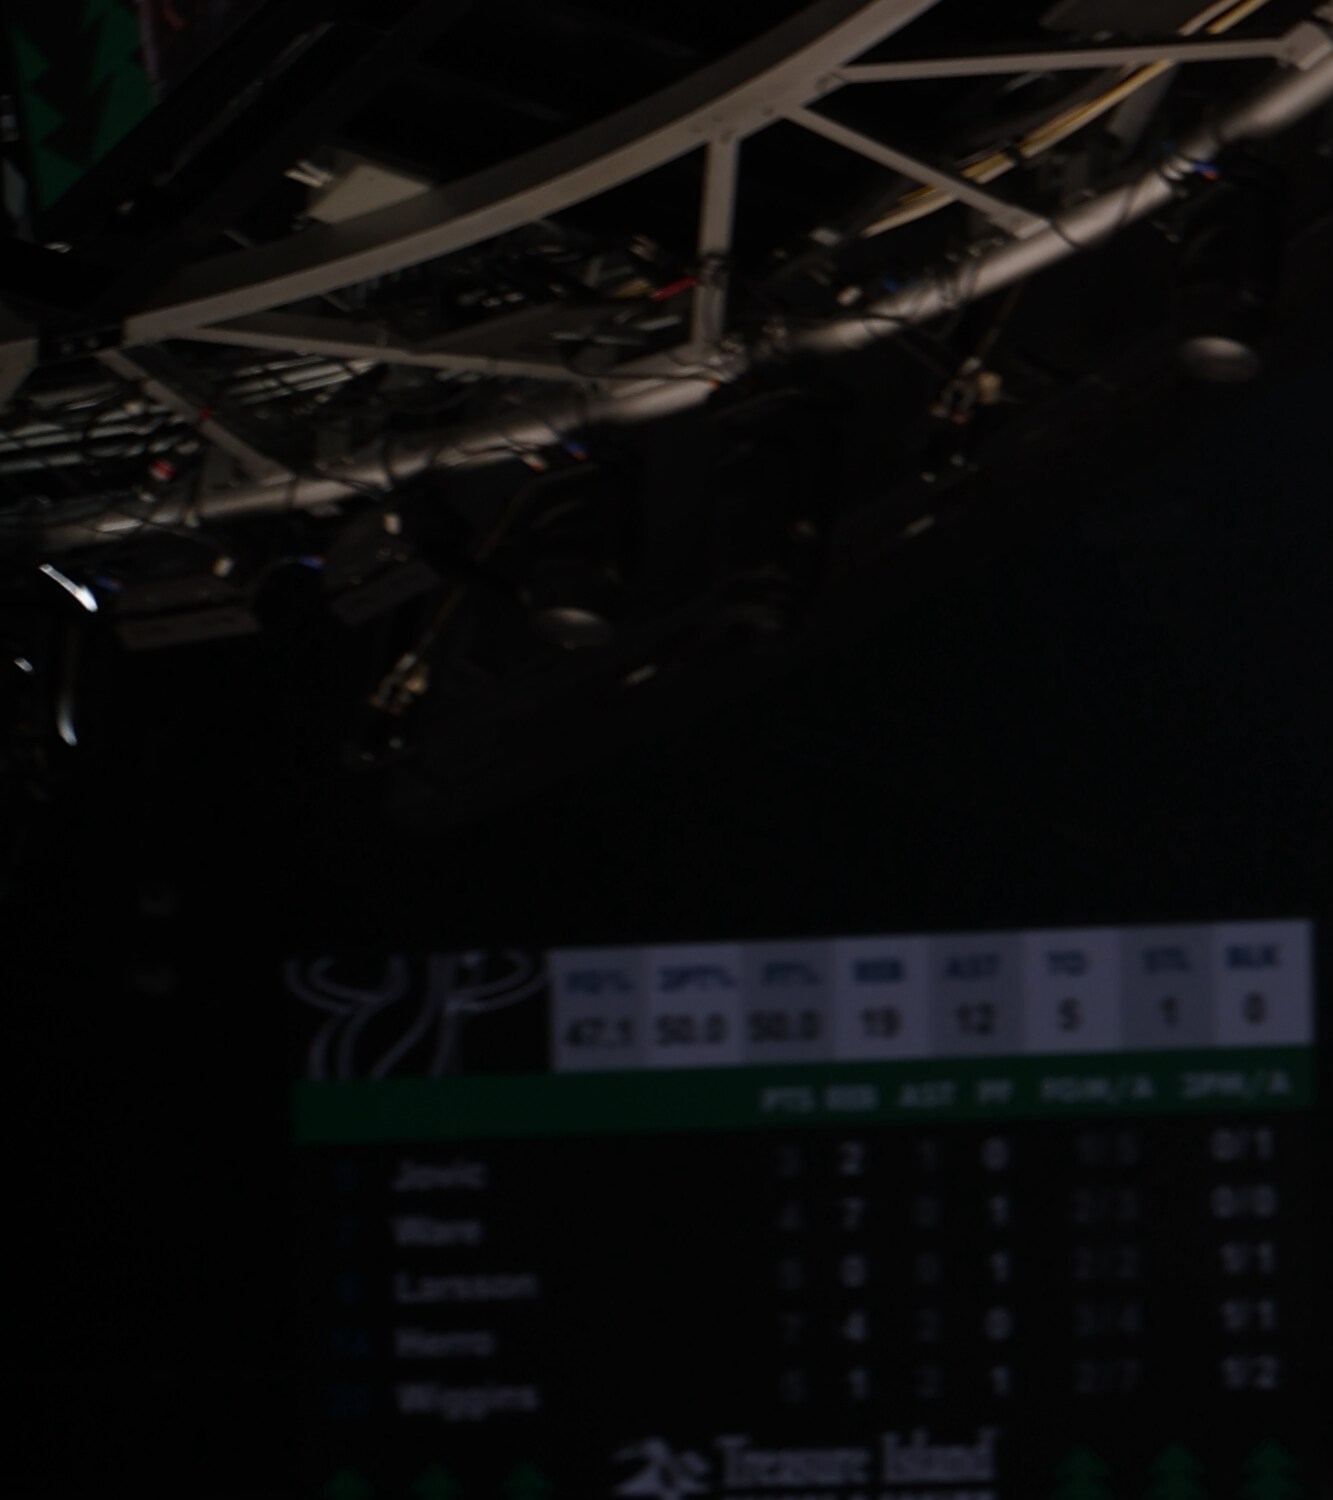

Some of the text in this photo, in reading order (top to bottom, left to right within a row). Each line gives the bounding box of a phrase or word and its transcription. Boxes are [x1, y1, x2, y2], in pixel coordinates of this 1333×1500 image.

[838, 1137, 866, 1176] 2
[980, 1136, 1010, 1171] 0
[838, 1194, 866, 1232] 7
[989, 1191, 1012, 1229] 1
[838, 1250, 869, 1289] 0
[989, 1248, 1012, 1286] 1
[840, 1308, 871, 1344] 4
[982, 1304, 1014, 1342] 0
[847, 1365, 871, 1403] 1
[989, 1361, 1013, 1399] 1
[712, 1425, 1002, 1488] Treasure Island
